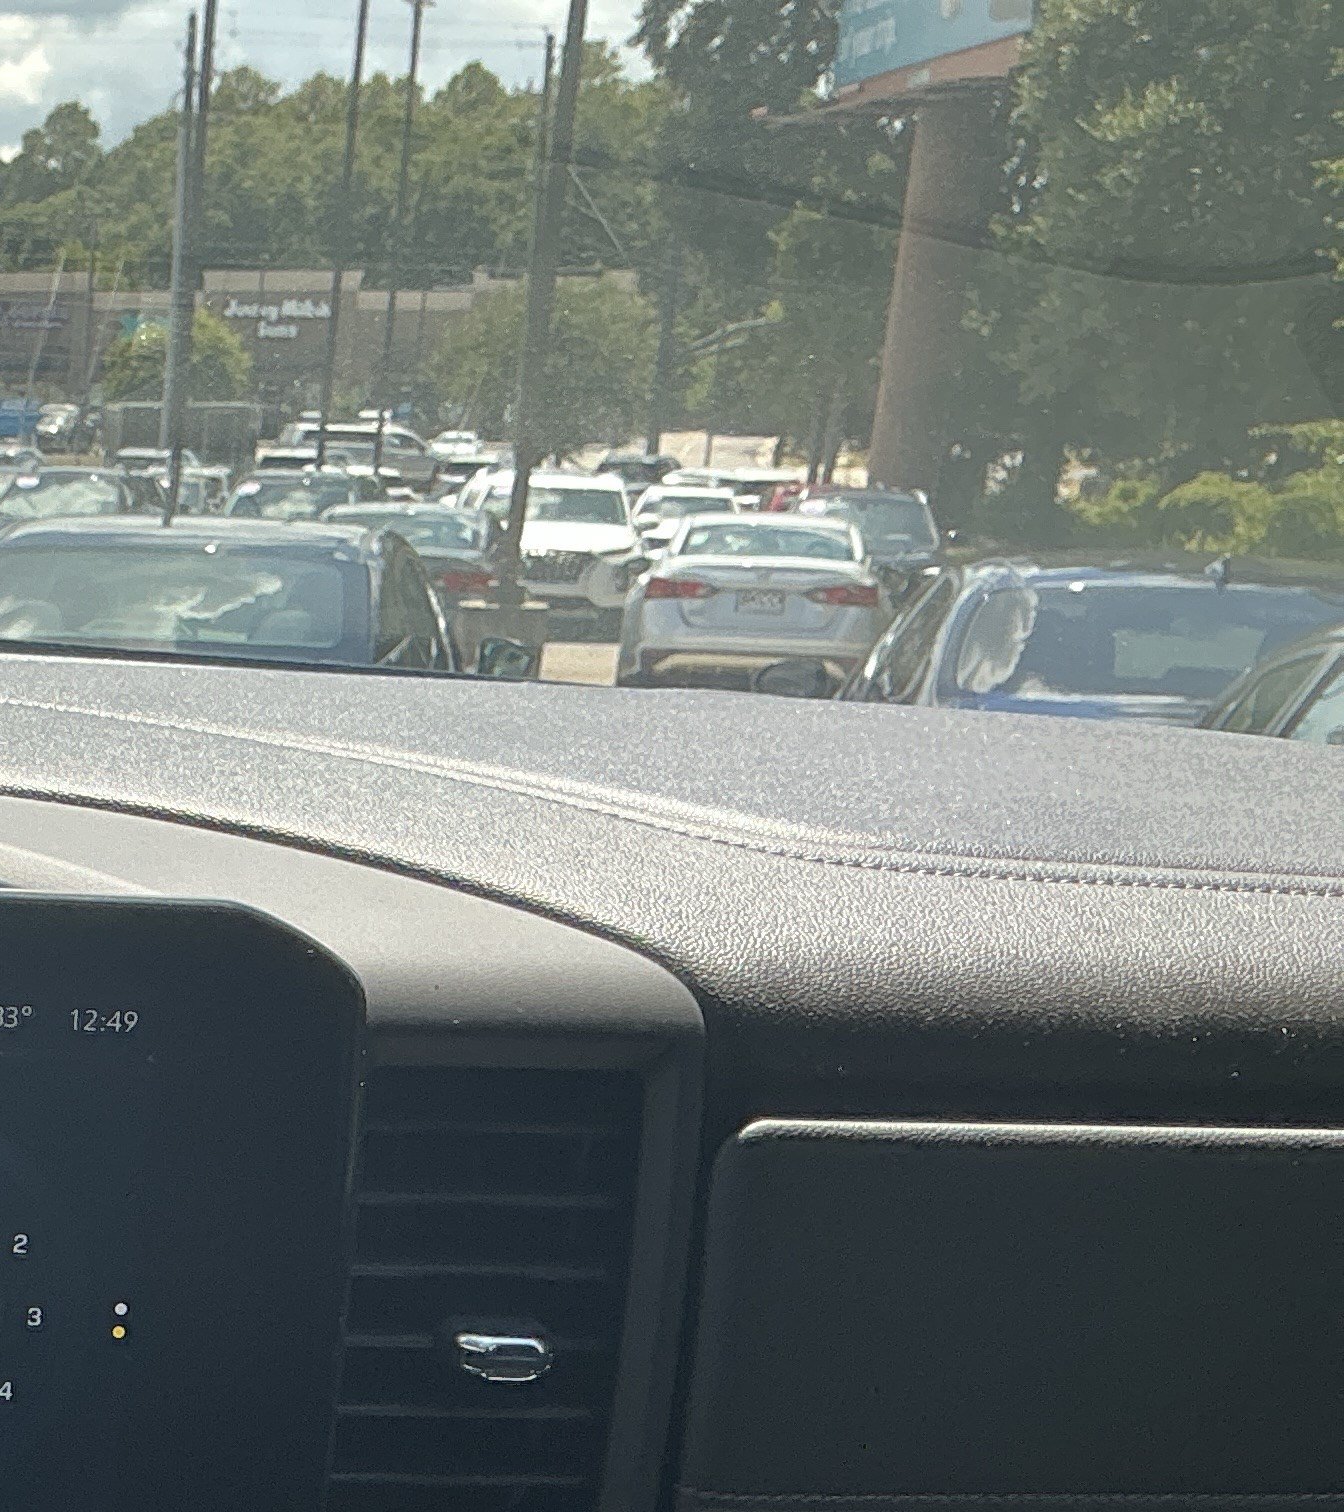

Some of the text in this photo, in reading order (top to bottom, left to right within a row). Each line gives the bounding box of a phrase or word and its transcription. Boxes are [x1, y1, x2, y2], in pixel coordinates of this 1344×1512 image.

[71, 1009, 139, 1033] 12:49
[13, 1234, 28, 1254] 2
[27, 1307, 42, 1327] 3
